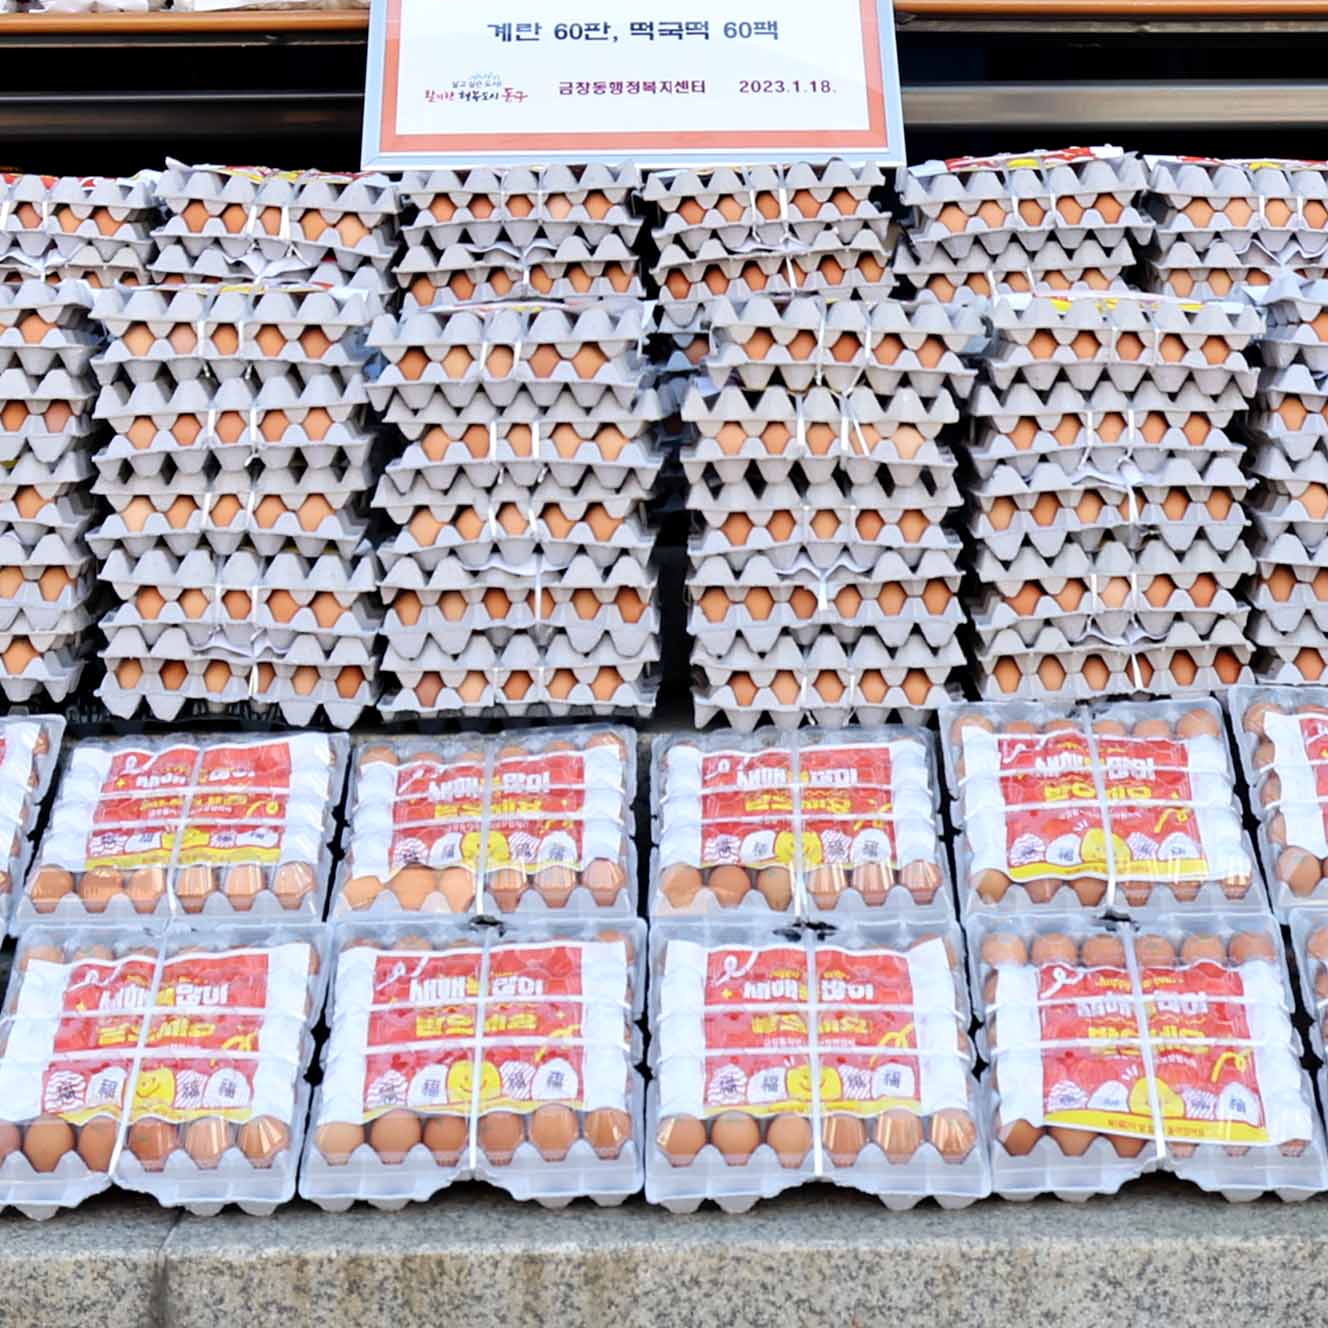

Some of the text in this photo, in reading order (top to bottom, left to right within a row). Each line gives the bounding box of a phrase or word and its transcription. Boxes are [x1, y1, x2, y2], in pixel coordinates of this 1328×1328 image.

[487, 20, 780, 45] 계란 60판, 떡국떡 60팩
[559, 79, 707, 97] 금창동행정복지센터
[738, 79, 838, 95] 2023.1.18.
